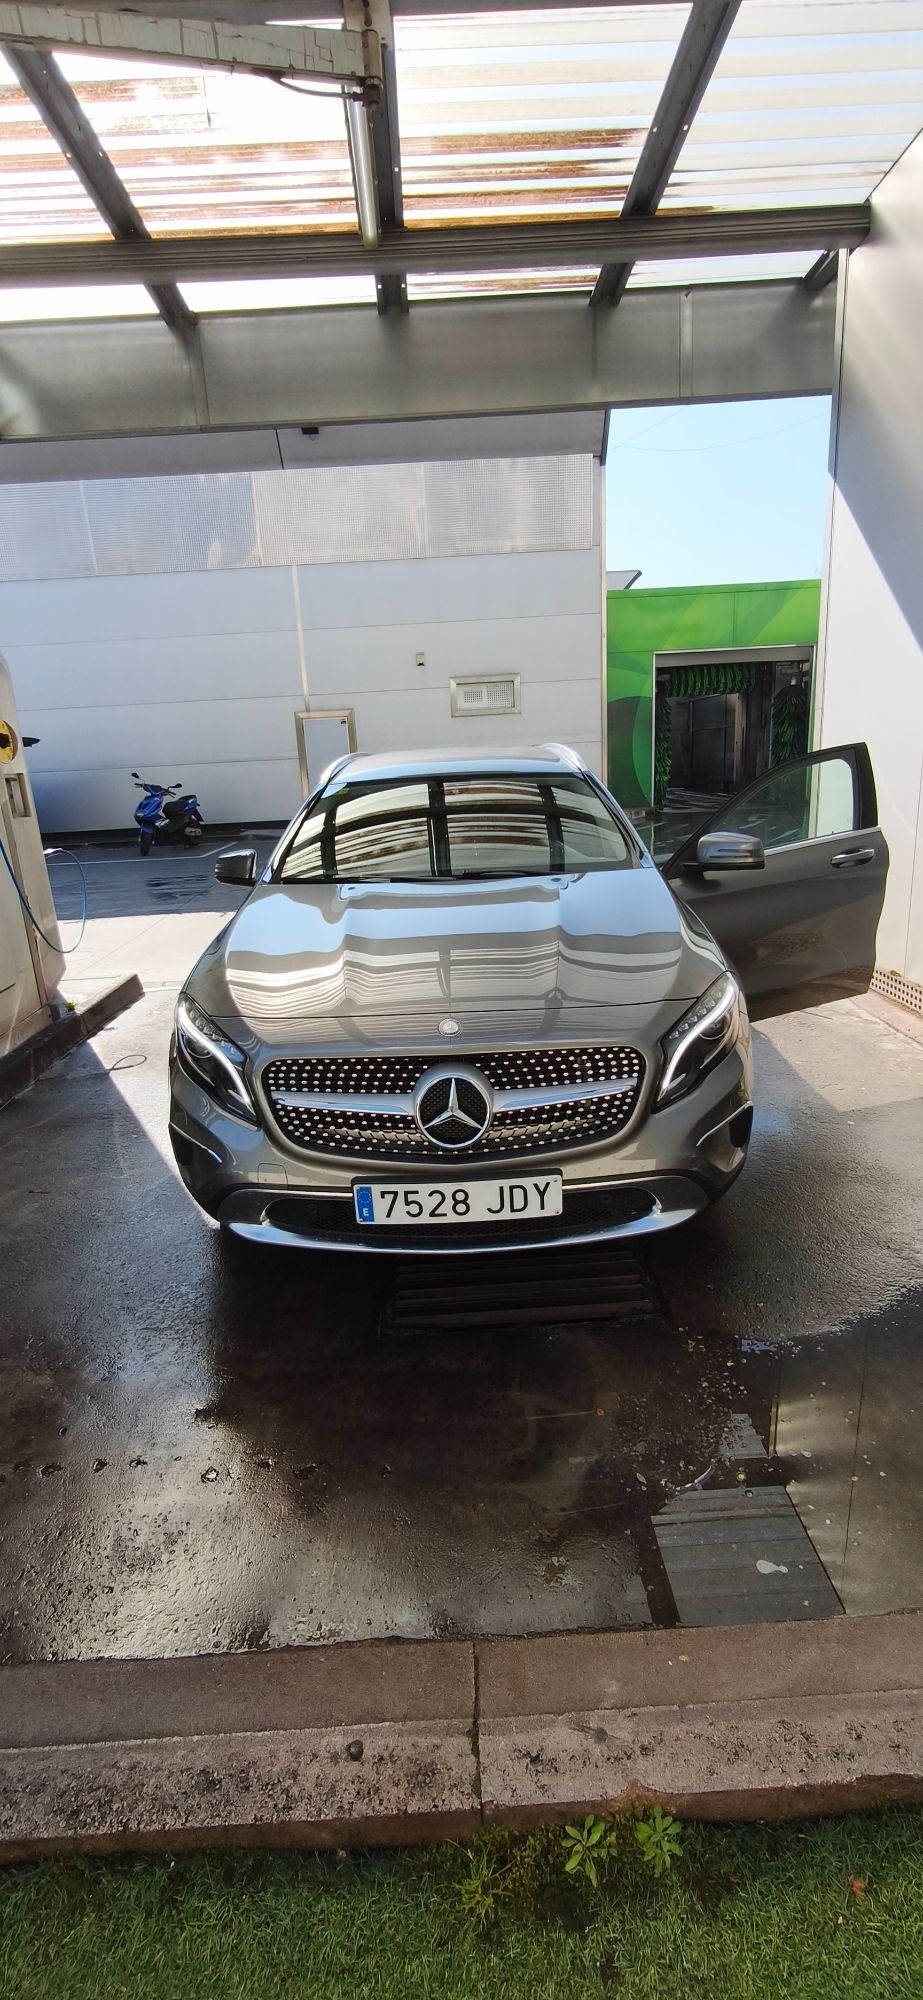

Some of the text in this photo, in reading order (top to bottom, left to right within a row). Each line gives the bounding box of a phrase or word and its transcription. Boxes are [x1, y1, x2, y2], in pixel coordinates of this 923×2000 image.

[380, 1181, 551, 1218] 7528 JDY
[362, 1208, 370, 1216] E
